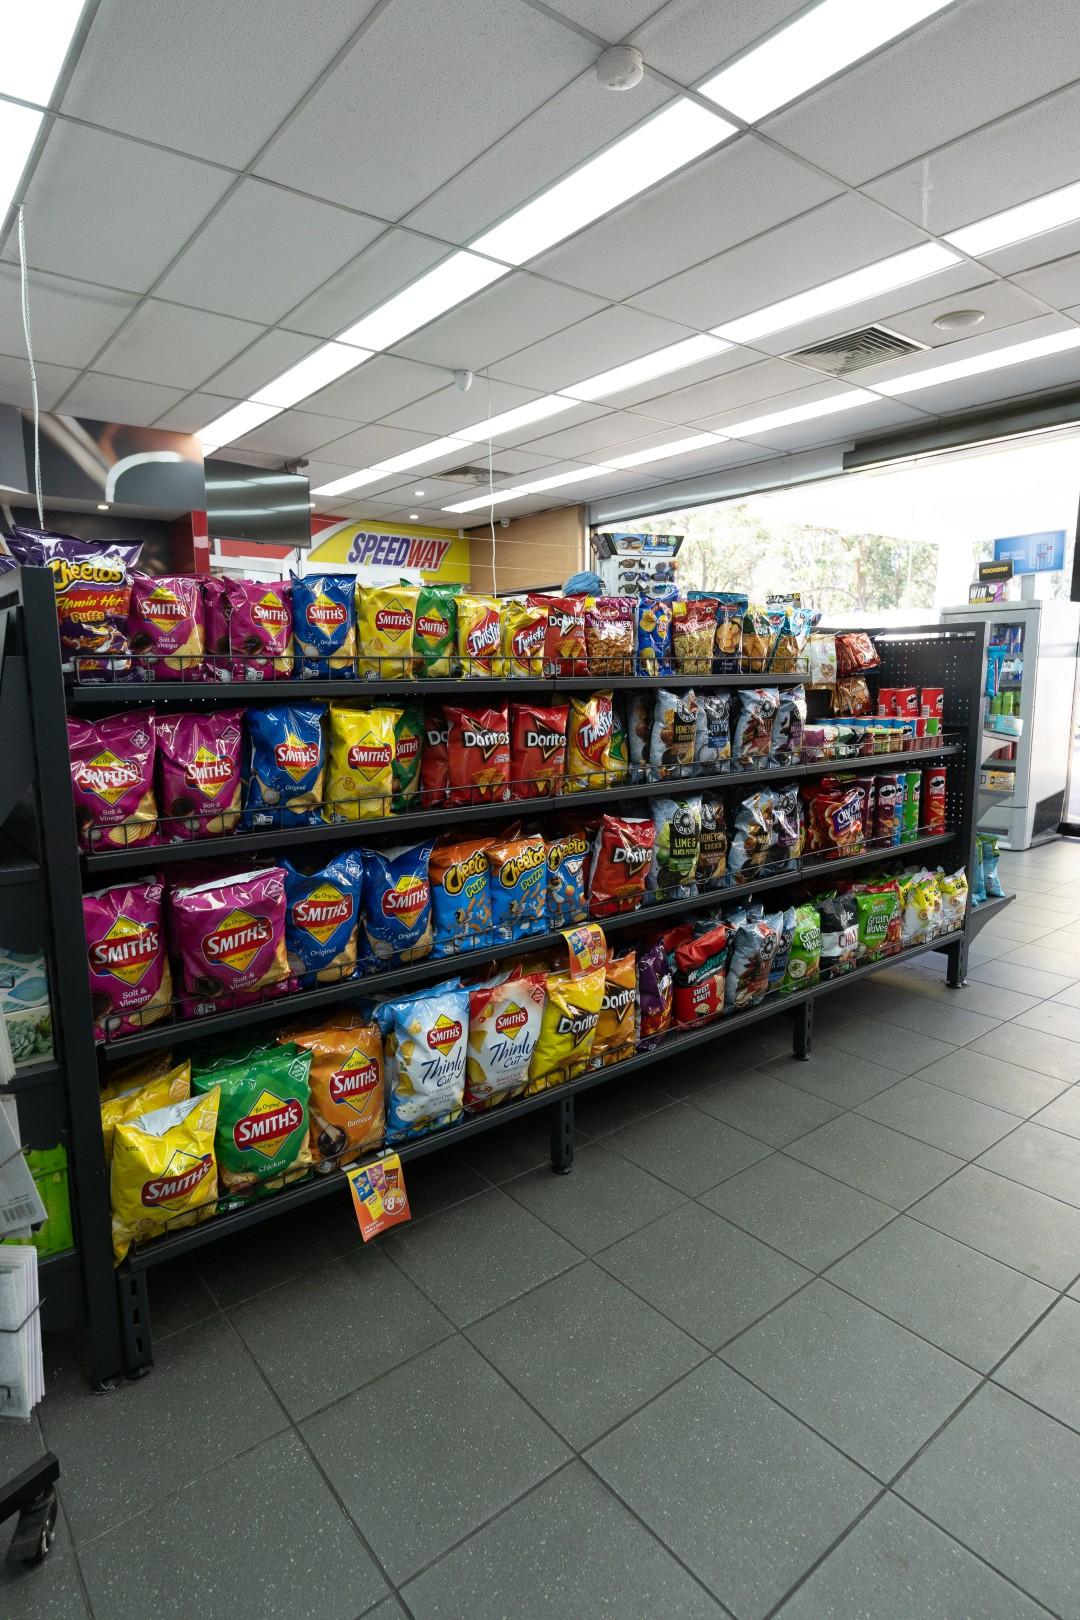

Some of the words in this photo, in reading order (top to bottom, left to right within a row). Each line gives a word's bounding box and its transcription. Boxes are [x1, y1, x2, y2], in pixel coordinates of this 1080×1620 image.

[347, 532, 450, 570] SPEEDWAY
[48, 559, 124, 591] Cheetos
[100, 594, 124, 608] Hot
[141, 601, 187, 616] SMITH'S
[70, 611, 105, 624] Puffs
[254, 606, 289, 622] SMITH'S
[308, 607, 345, 621] SMITH'S
[376, 611, 412, 626] SMITH'S
[416, 619, 447, 635] SMITH'S
[464, 730, 510, 748] Doritos
[276, 747, 317, 764] SMITH'S
[350, 748, 391, 763] SMITH'S
[396, 740, 420, 757] SMITH'S
[187, 761, 232, 780] SMITH'S
[100, 814, 125, 823] Vinegar
[674, 838, 692, 848] LIME
[521, 867, 545, 891] Puffs
[385, 885, 428, 909] SMITH'S
[296, 899, 349, 922] SMITH'S
[867, 913, 889, 925] Grain
[397, 929, 420, 941] Original
[866, 924, 888, 935] Waves
[207, 924, 268, 956] SMITH'S
[94, 932, 159, 965] SMITH'S
[310, 946, 337, 957] Original
[232, 975, 245, 985] Salt
[122, 990, 139, 1000] Salt
[693, 983, 710, 997] SWEET
[119, 993, 152, 1008] Vinegar
[497, 1012, 527, 1028] SMITH'S
[429, 1026, 461, 1045] SMITH'S
[489, 1030, 538, 1067] Thinly
[421, 1046, 466, 1085] Thinly
[503, 1054, 523, 1069] Cut
[333, 1066, 377, 1095] SMITH'S
[436, 1071, 453, 1088] Cut
[239, 1107, 299, 1143] SMITH'S
[258, 1159, 287, 1173] Chicken
[145, 1160, 214, 1201] SMITH'S
